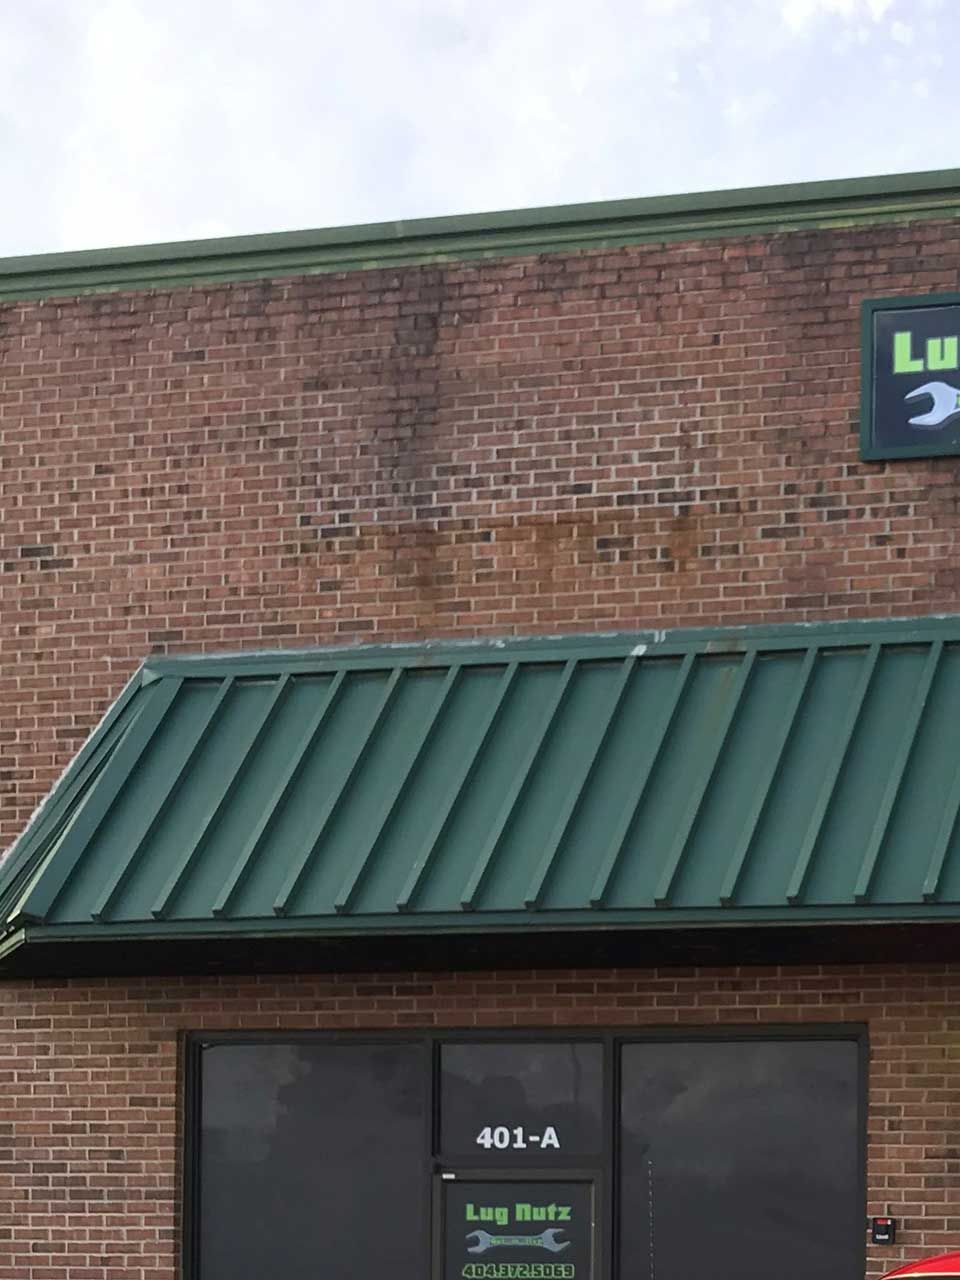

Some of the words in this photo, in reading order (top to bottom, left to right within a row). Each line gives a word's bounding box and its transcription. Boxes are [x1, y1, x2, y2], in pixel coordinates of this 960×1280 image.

[476, 1126, 560, 1149] 401-A
[466, 1203, 509, 1225] Lug
[515, 1203, 572, 1221] Nutz
[462, 1263, 576, 1280] 404.372.5069
